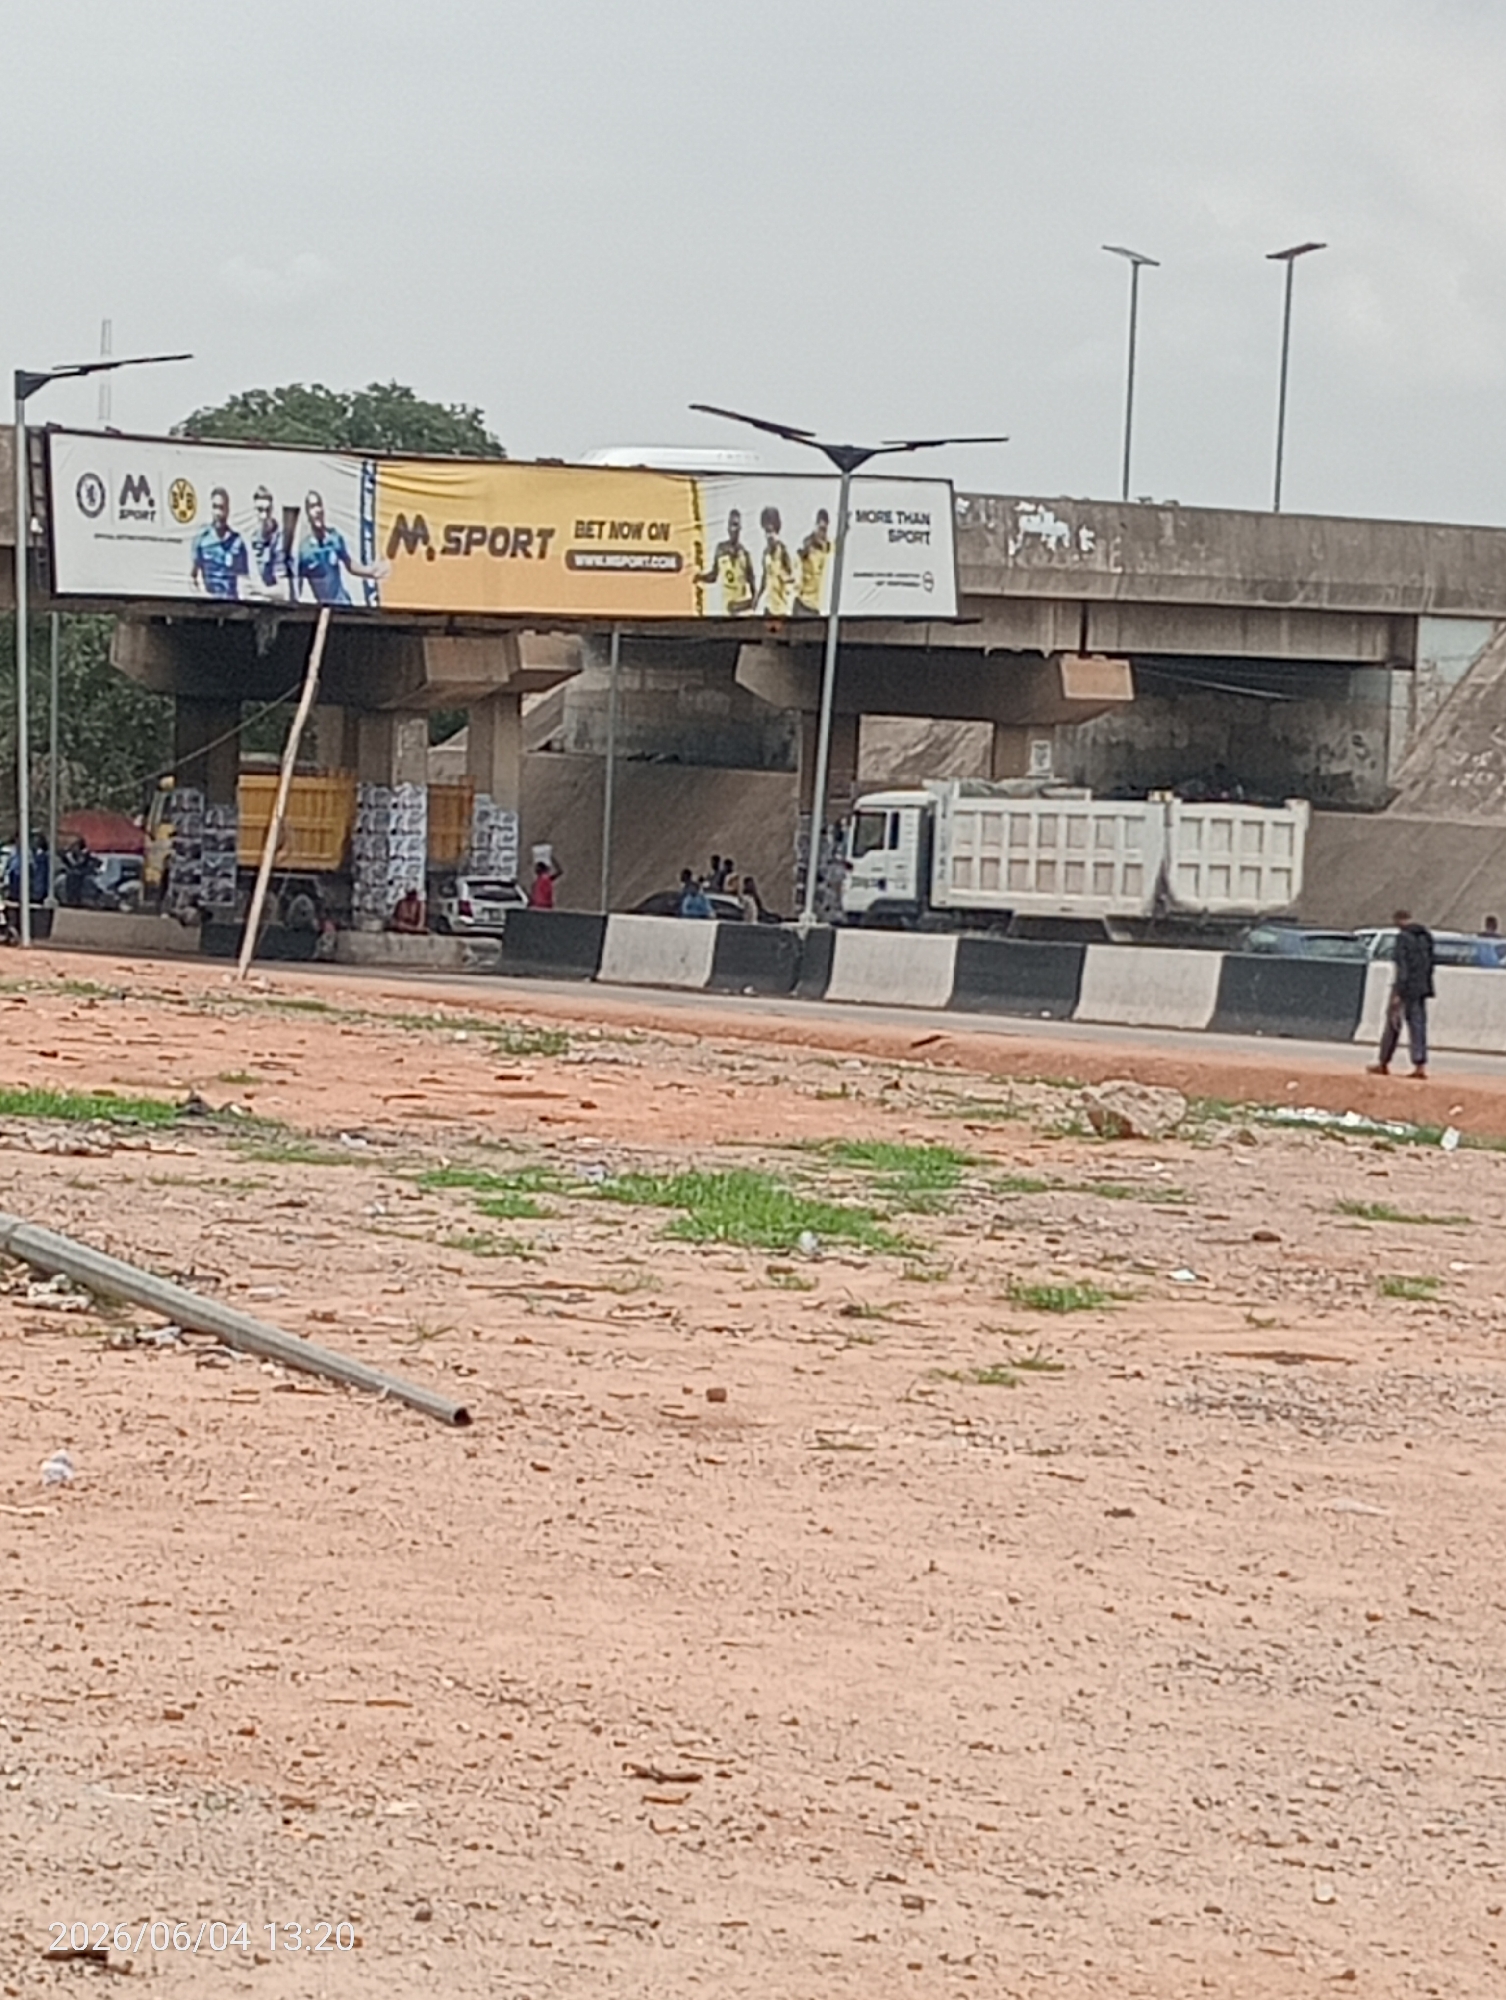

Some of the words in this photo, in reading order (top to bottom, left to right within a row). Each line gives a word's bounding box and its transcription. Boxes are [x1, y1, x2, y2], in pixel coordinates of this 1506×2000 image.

[118, 508, 156, 523] SPORT
[855, 509, 893, 524] MORE
[895, 510, 931, 526] THAN
[574, 519, 606, 541] BET
[607, 521, 645, 541] NOW
[647, 522, 671, 542] ON
[888, 528, 931, 546] SPORT
